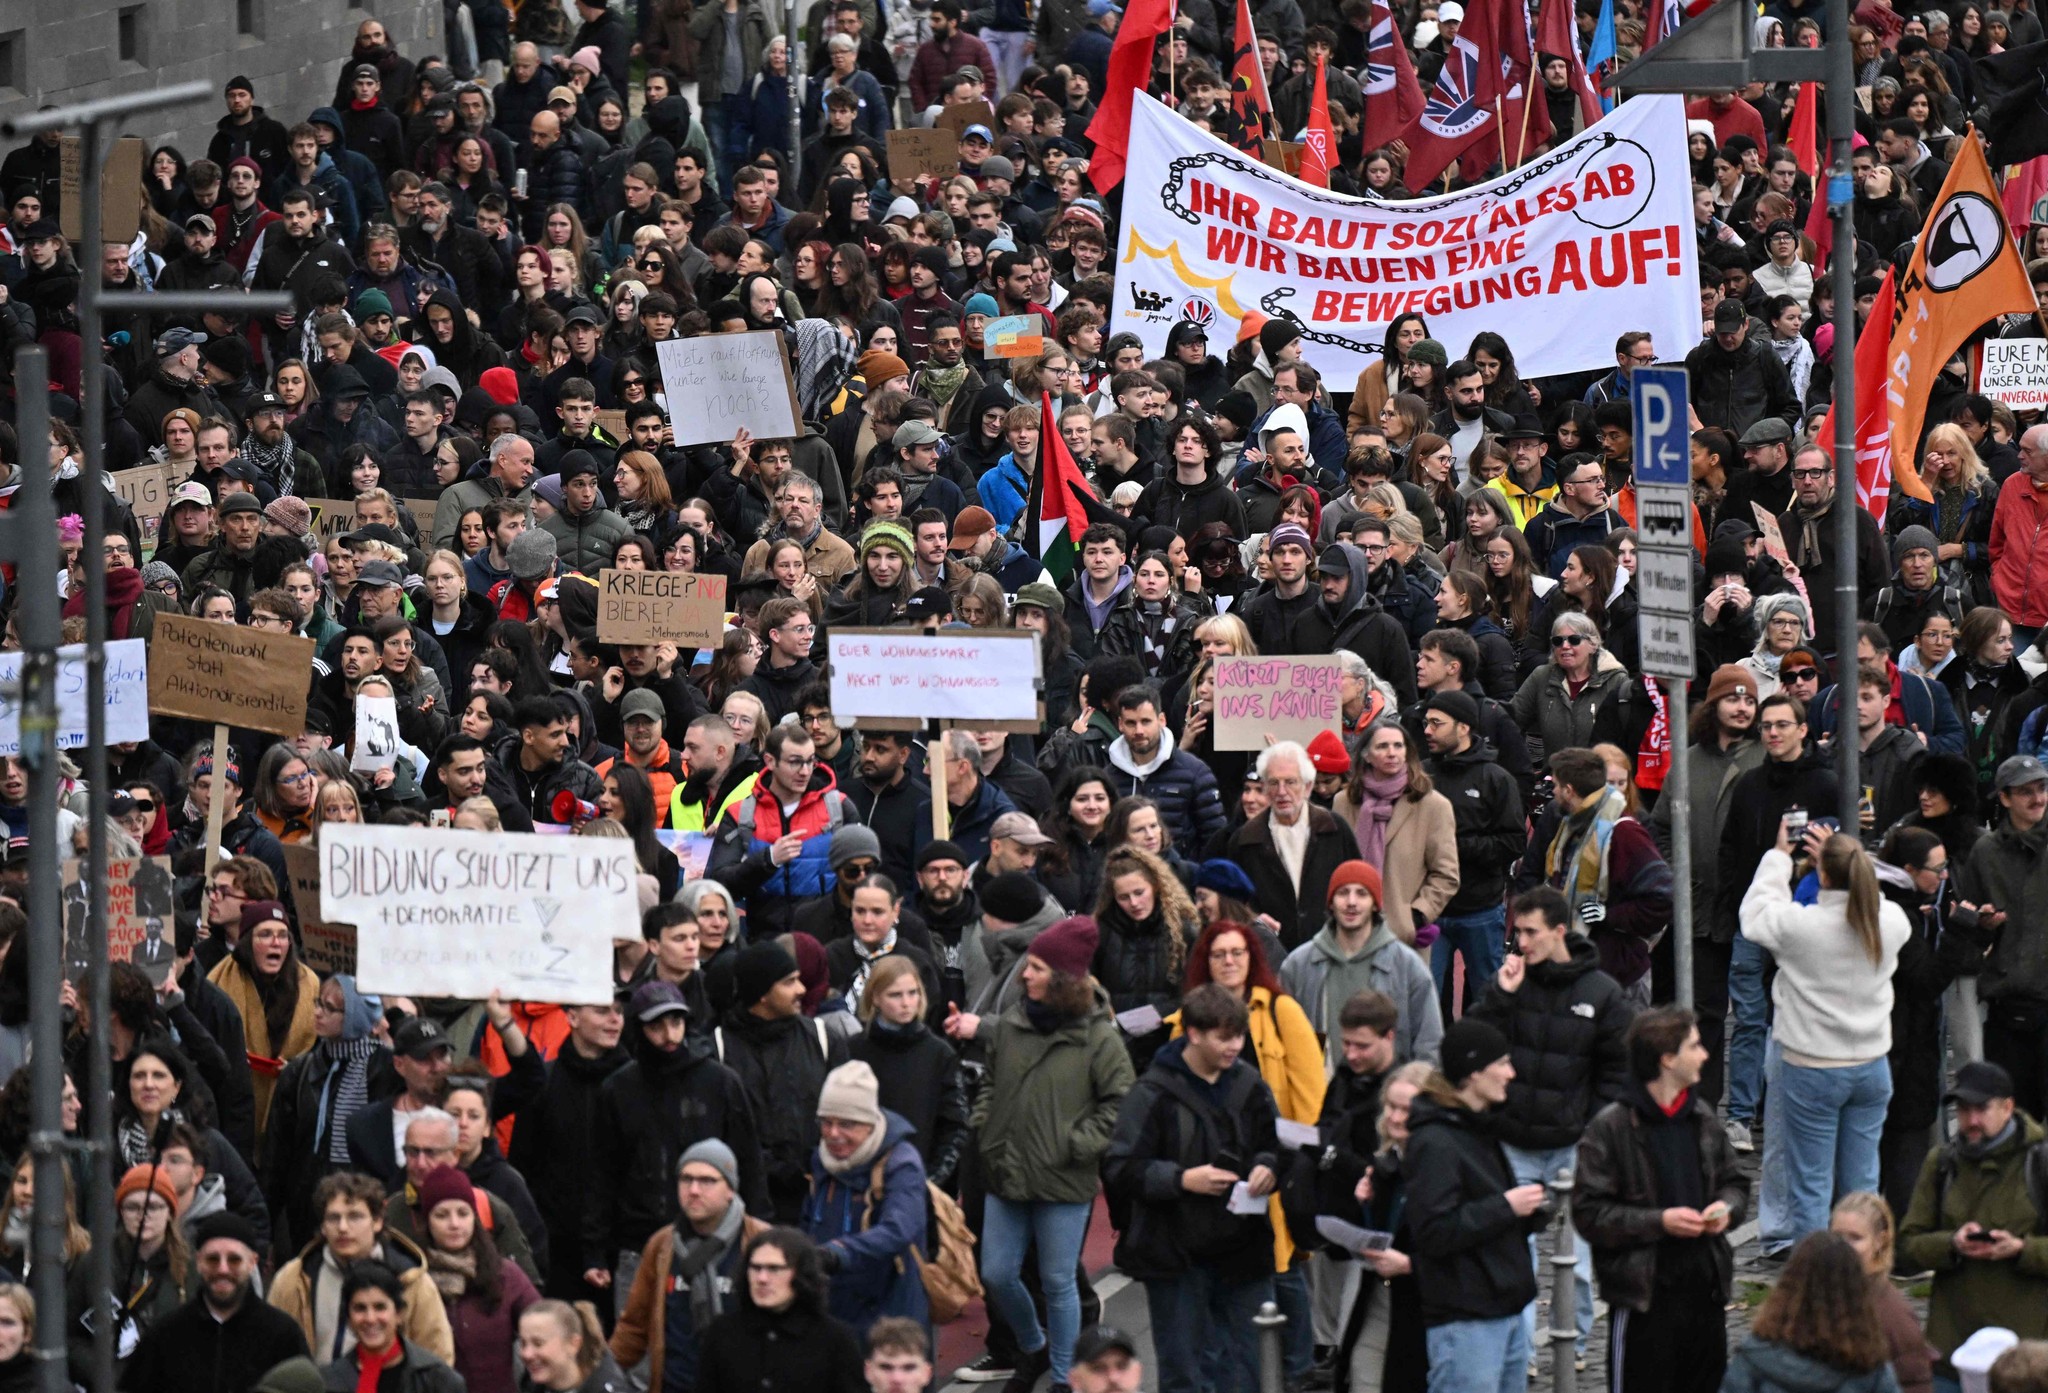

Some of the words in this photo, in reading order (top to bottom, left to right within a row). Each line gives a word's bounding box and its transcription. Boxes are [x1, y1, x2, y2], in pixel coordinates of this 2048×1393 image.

[890, 133, 920, 145] Herz
[1190, 178, 1258, 231] IHR
[1267, 207, 1387, 250] BAUT
[1583, 163, 1636, 202] AB
[1207, 226, 1287, 274] WIR
[1296, 252, 1436, 283] BAUEN
[1446, 230, 1526, 276] EINE
[1312, 266, 1542, 322] BEWEGUNG
[1547, 225, 1681, 294] AUF!
[661, 343, 705, 372] Miete
[1987, 345, 2031, 363] EURE
[665, 371, 707, 391] runter
[2012, 363, 2048, 375] DUN
[1984, 376, 2022, 388] UNSER
[1641, 383, 1673, 469] P
[698, 577, 726, 600] NO
[1643, 570, 1652, 586] 10
[1654, 570, 1686, 592] Minuten
[606, 600, 674, 624] BIERE?
[161, 622, 267, 661] Patientenwohl
[838, 644, 871, 658] EUER
[1217, 659, 1291, 689] KÜRZT
[166, 674, 299, 715] Aktionärsrendite
[1221, 693, 1265, 720] INS
[329, 842, 448, 899] BILDUNG
[576, 853, 629, 894] UNS
[117, 915, 127, 926] A
